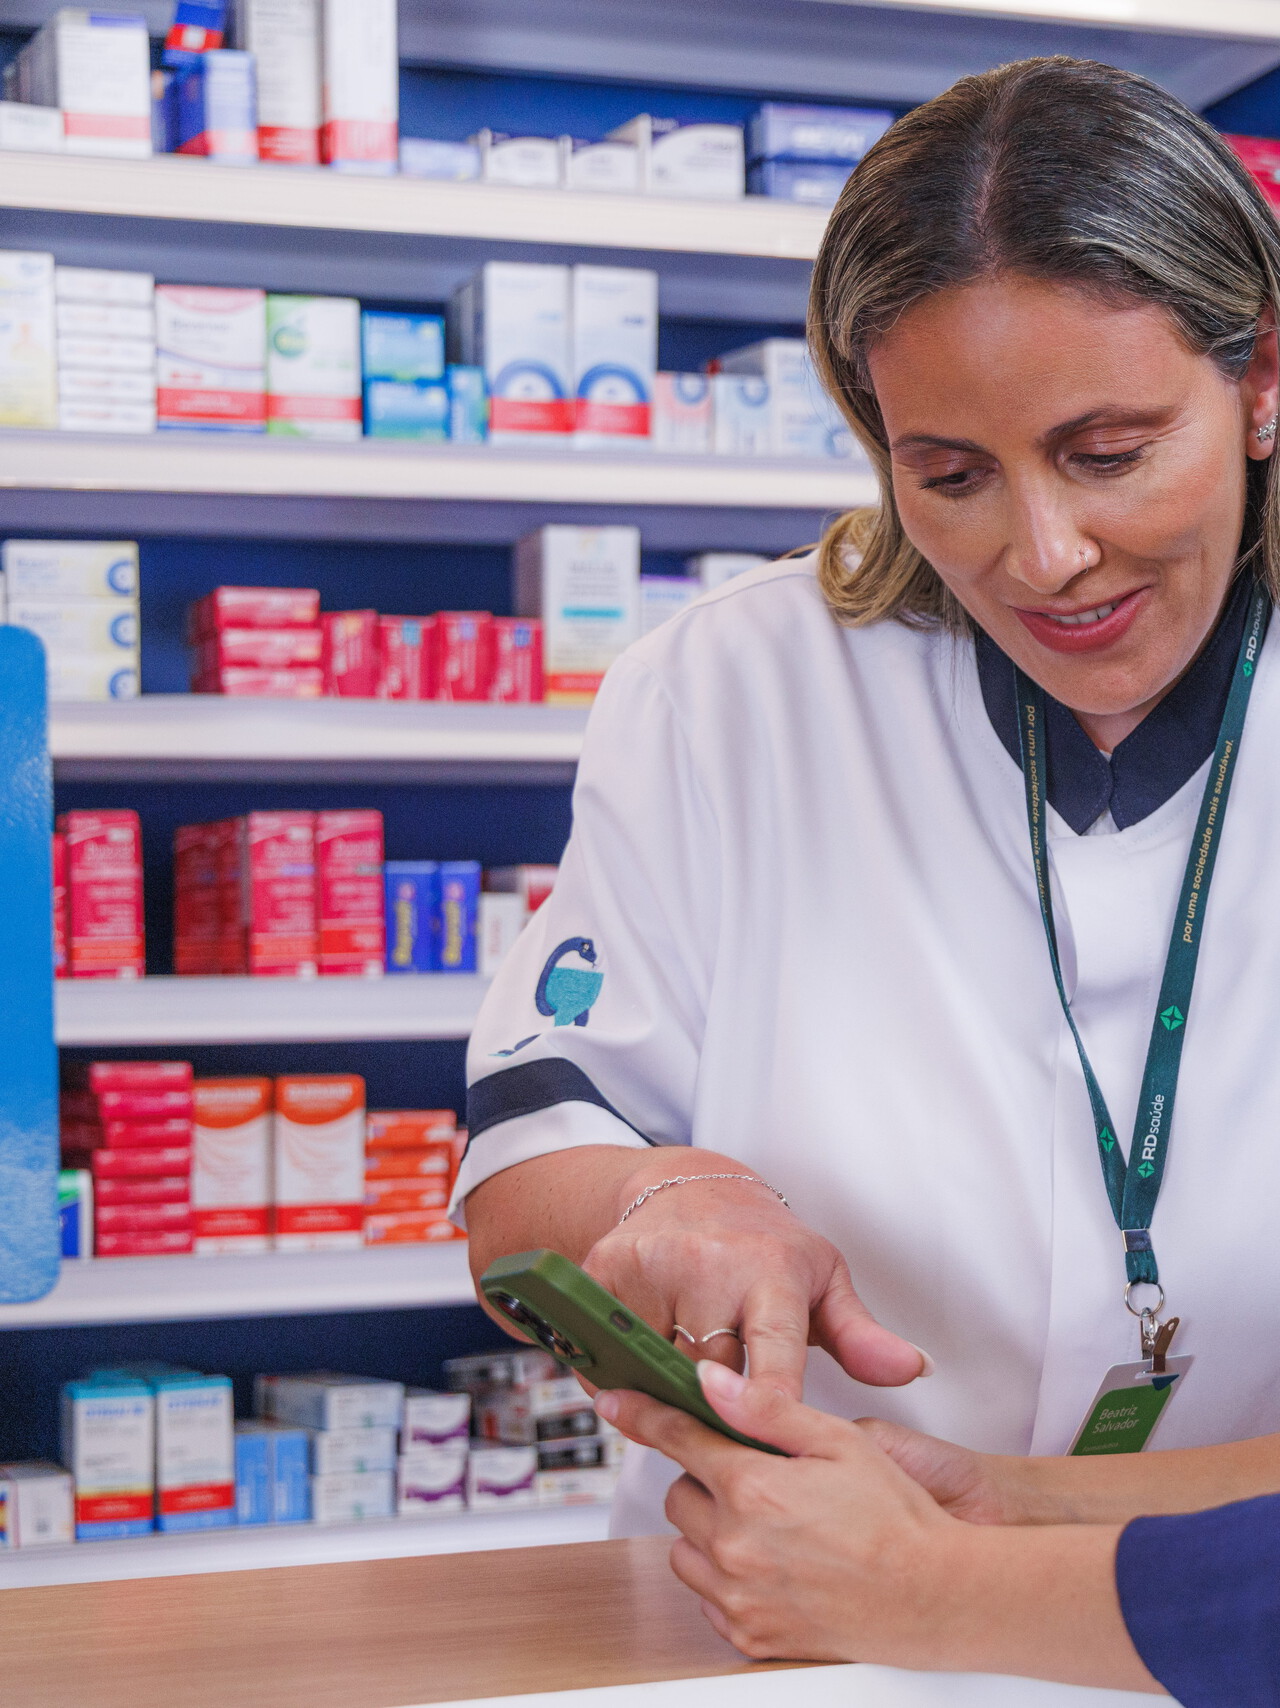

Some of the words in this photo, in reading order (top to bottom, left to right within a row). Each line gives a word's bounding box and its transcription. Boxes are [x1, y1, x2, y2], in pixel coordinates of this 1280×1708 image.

[1025, 705, 1035, 728] por
[1027, 729, 1036, 757] uma
[1214, 740, 1234, 795] saudável.
[1030, 760, 1041, 824] sociedade
[1208, 796, 1220, 826] mais
[1193, 827, 1213, 890] sociedade
[1187, 892, 1199, 919] uma
[1183, 920, 1193, 943] por
[1099, 1404, 1139, 1420] Beatriz
[1092, 1418, 1140, 1434] Salvador
